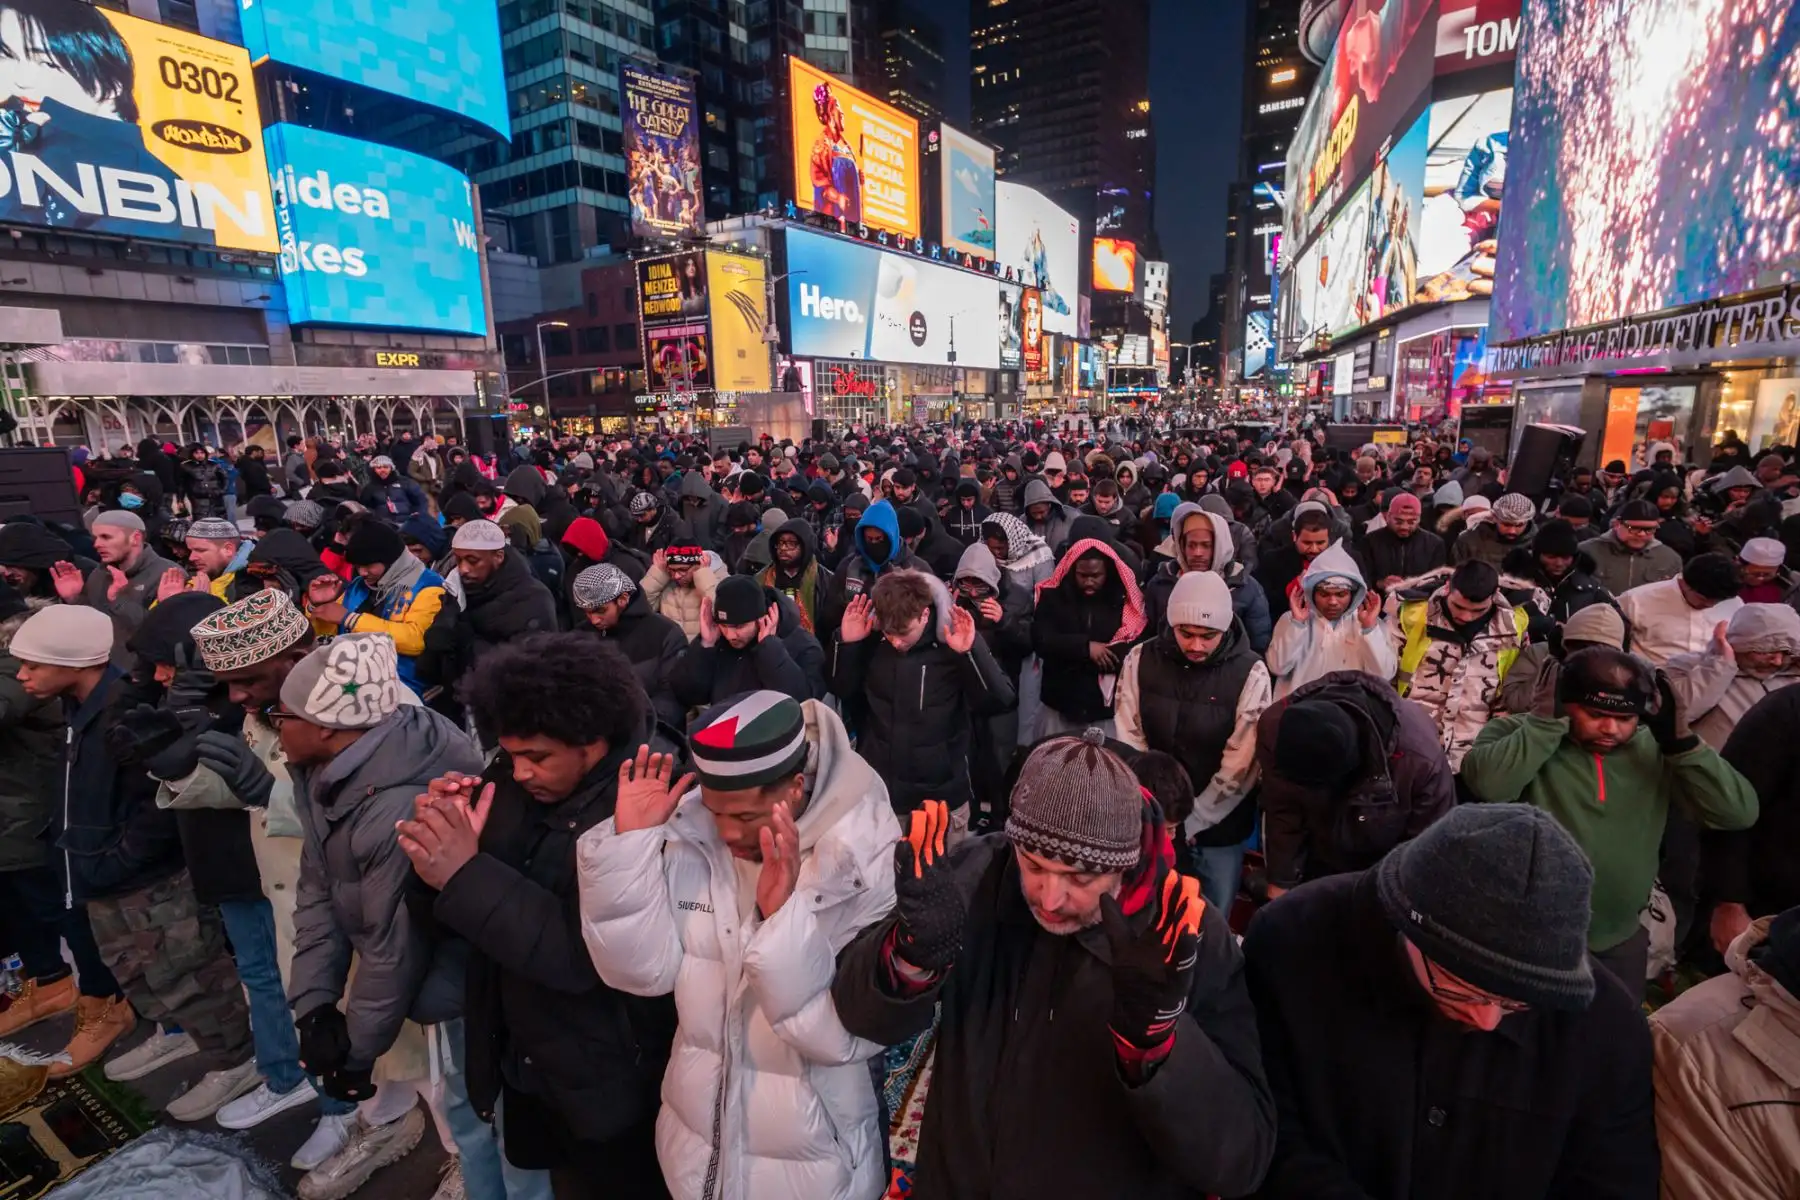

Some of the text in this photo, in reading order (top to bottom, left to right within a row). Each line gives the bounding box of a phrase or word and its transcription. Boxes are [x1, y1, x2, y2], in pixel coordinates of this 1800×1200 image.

[158, 55, 242, 104] 0302
[627, 90, 649, 113] THE
[651, 99, 690, 124] GREAT
[1259, 96, 1305, 115] SAMSUNG
[636, 111, 685, 136] GATSBY
[863, 136, 905, 170] VISTA
[928, 143, 938, 152] LG
[863, 157, 905, 188] SOCIAL
[0, 150, 265, 237] NBIN
[864, 178, 906, 206] CLUB
[648, 263, 672, 280] IDINA
[644, 277, 679, 296] MENZEL
[644, 297, 681, 315] REDWOOD
[799, 282, 864, 324] Hero.
[376, 352, 420, 367] EXPR
[1561, 327, 1621, 366] EAGLE
[634, 394, 657, 404] GIFTS
